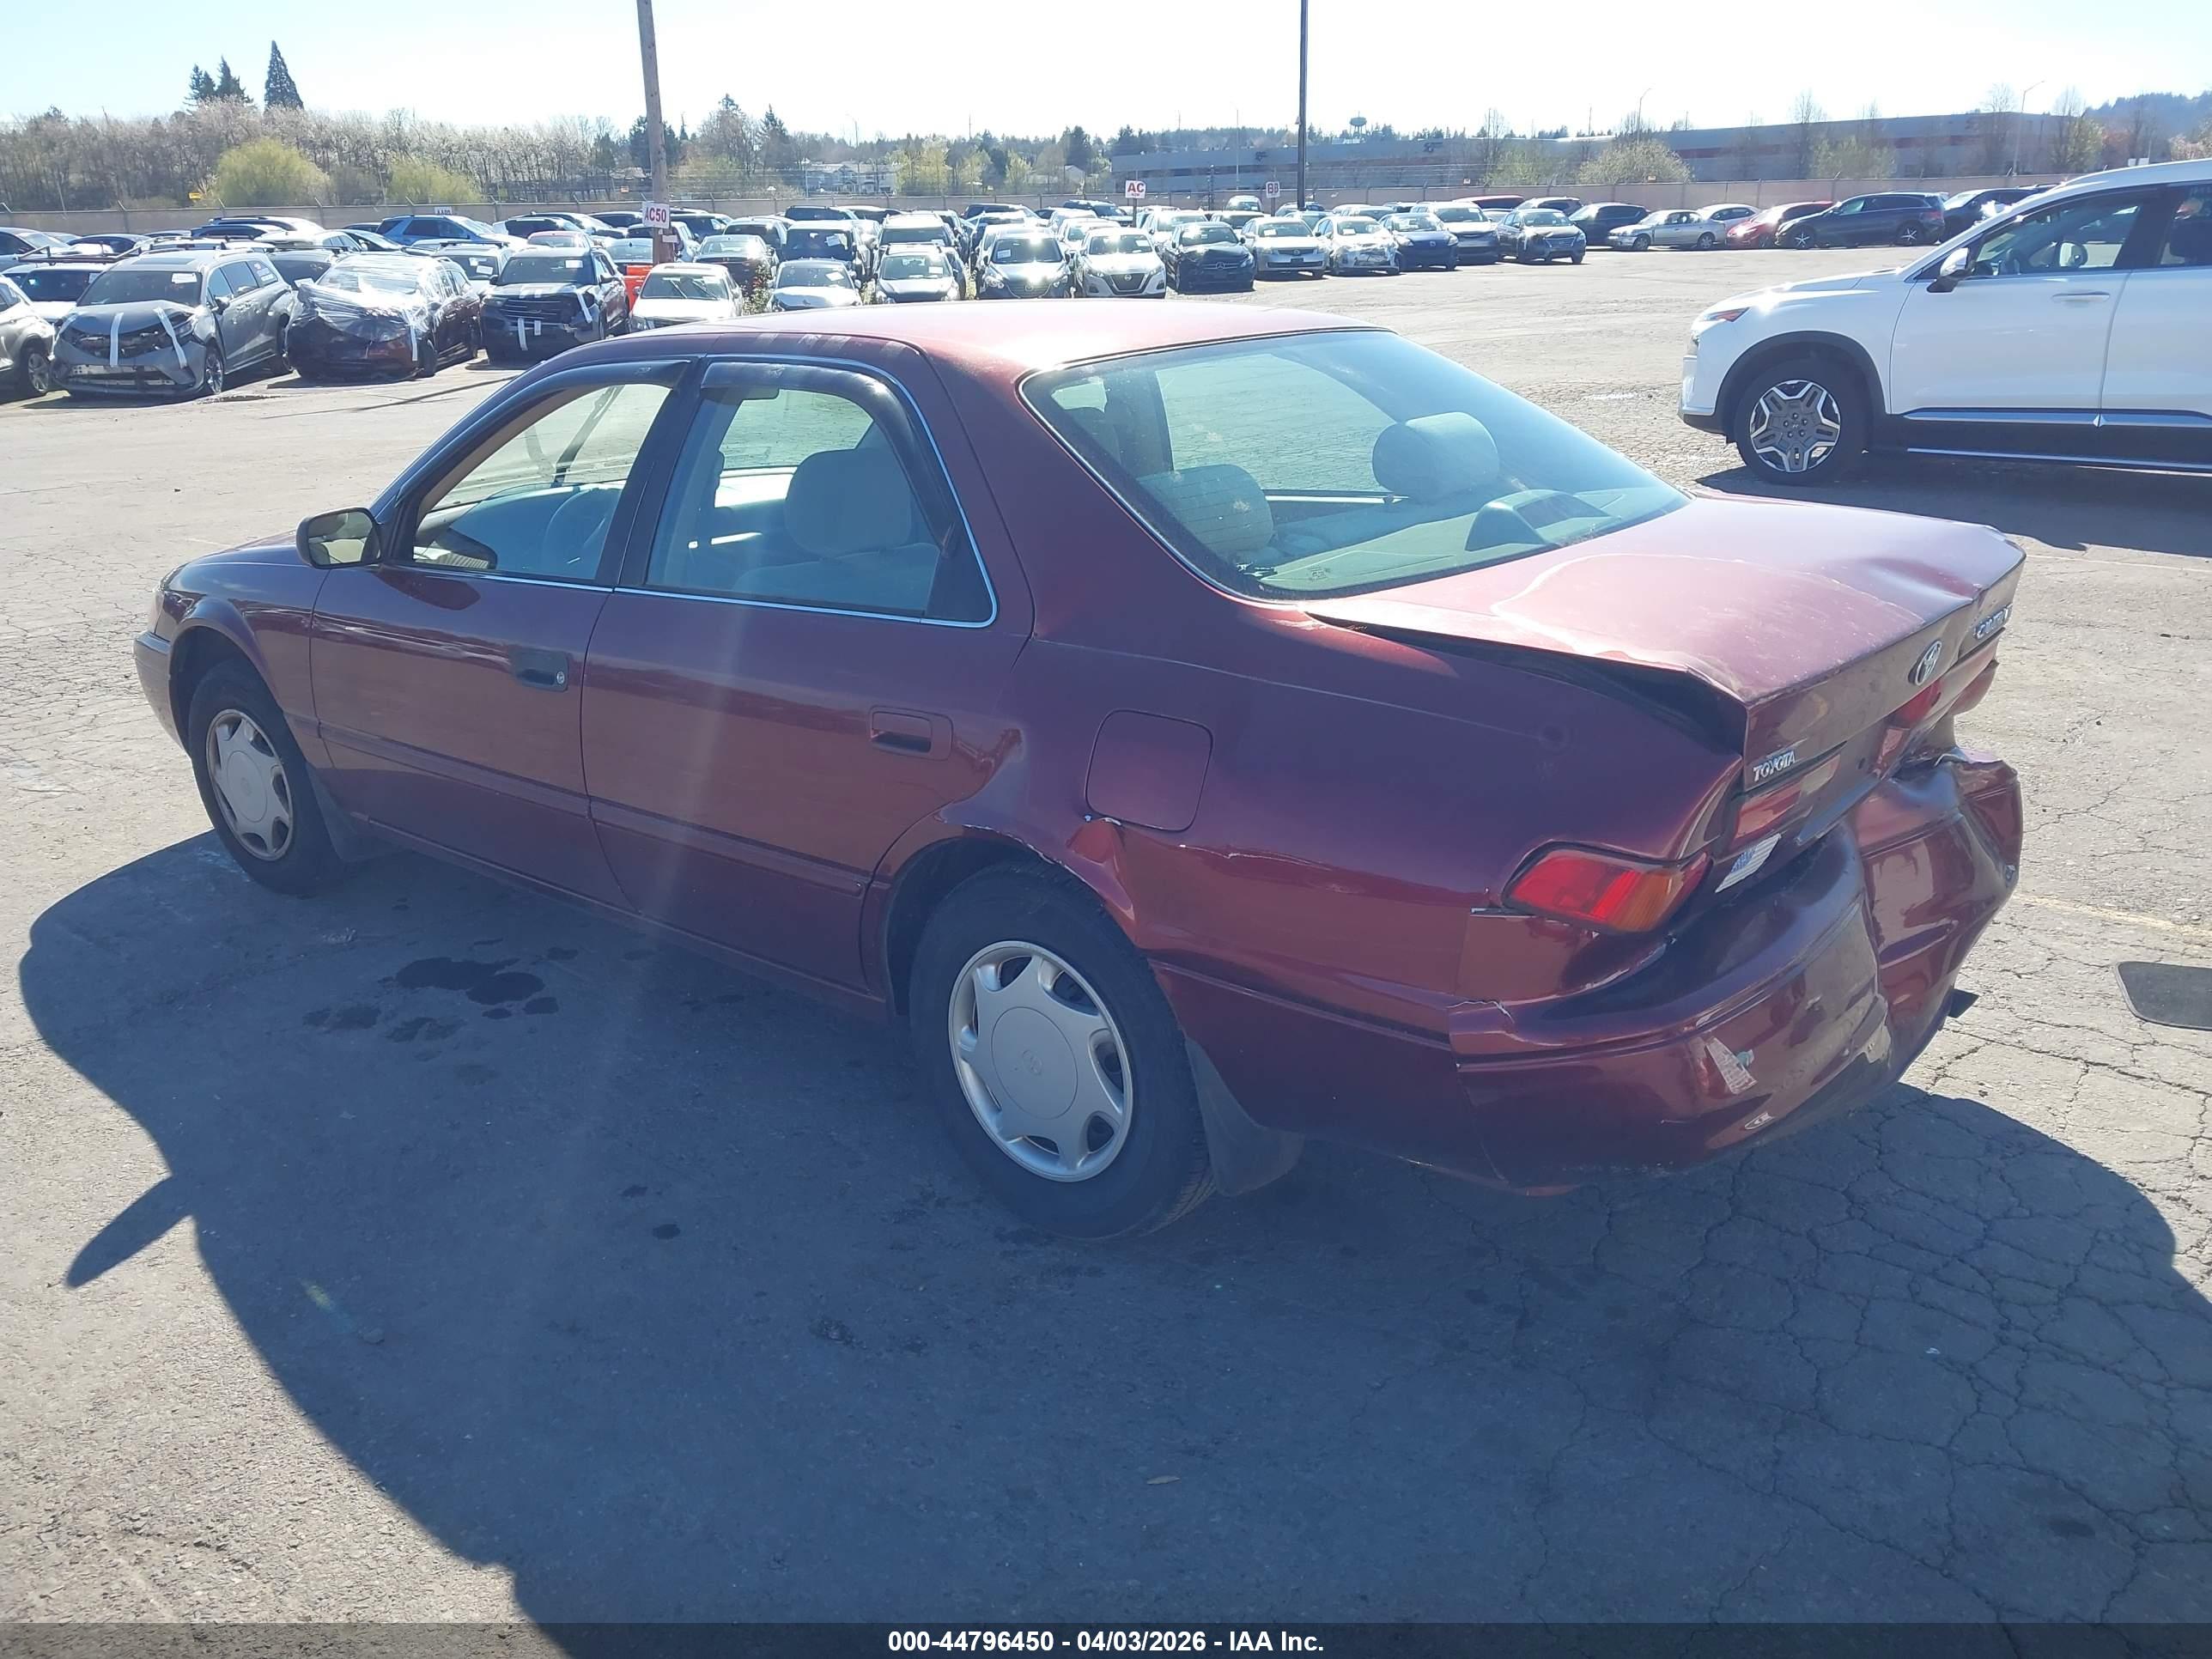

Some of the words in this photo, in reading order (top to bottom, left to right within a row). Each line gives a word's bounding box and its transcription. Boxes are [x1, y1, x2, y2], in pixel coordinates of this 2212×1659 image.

[1127, 182, 1145, 192] AC
[645, 207, 667, 223] AC50
[1753, 750, 1796, 782] TOYOTA
